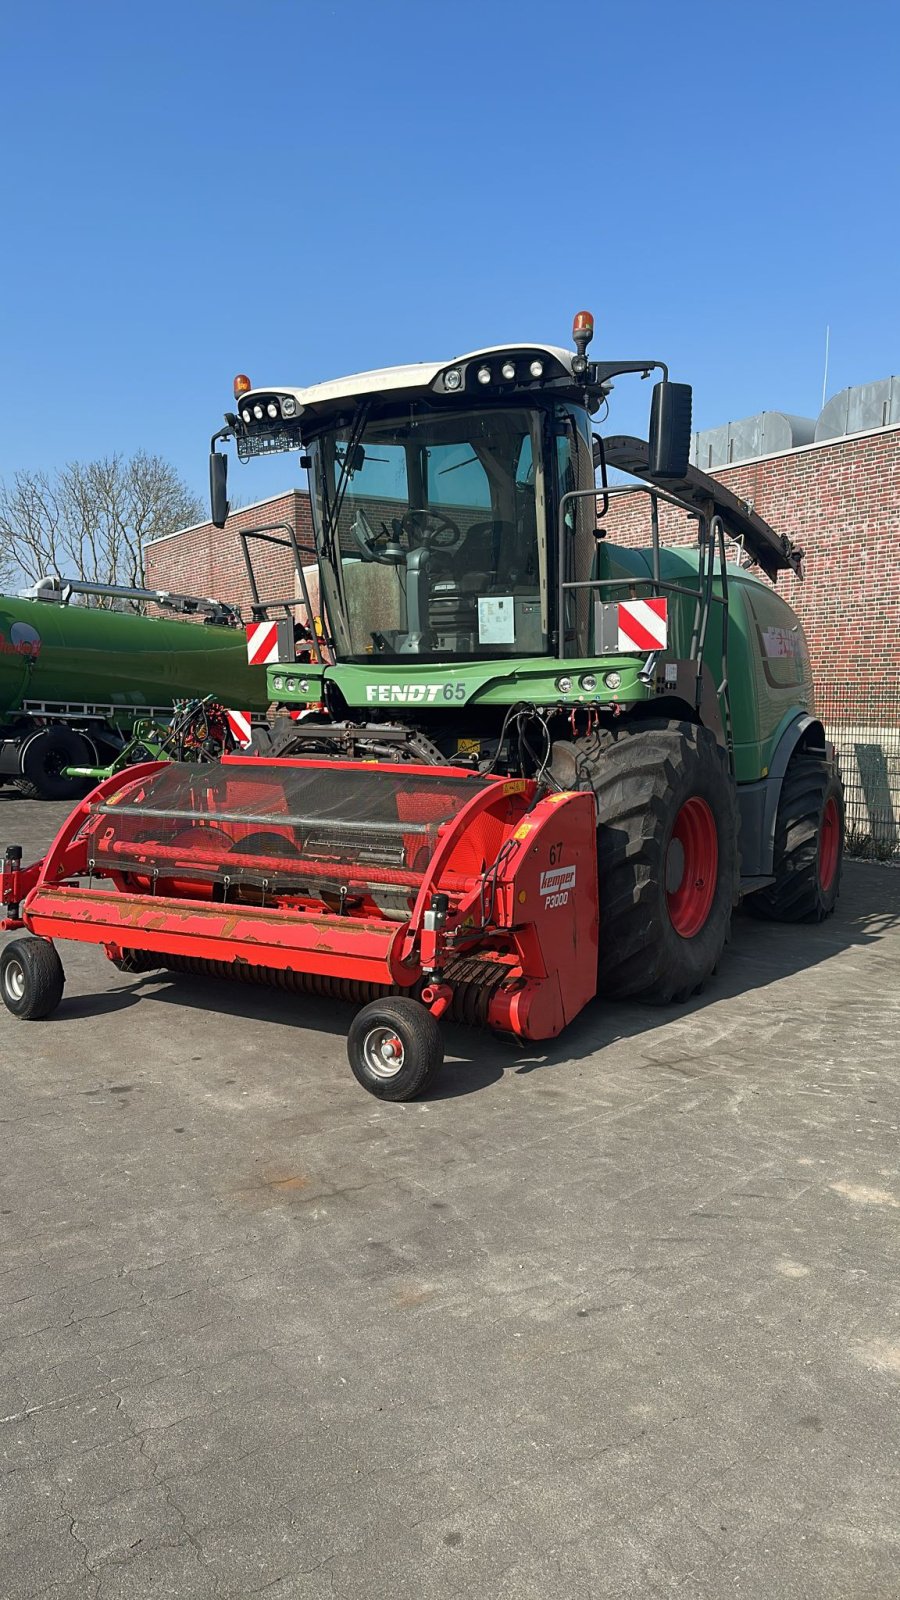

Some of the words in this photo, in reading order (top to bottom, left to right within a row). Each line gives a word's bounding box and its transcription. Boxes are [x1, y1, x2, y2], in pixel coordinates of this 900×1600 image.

[366, 685, 444, 701] FENDT
[443, 683, 466, 700] 65
[550, 842, 563, 865] 67
[541, 871, 574, 889] kemper
[544, 891, 569, 910] P3000
